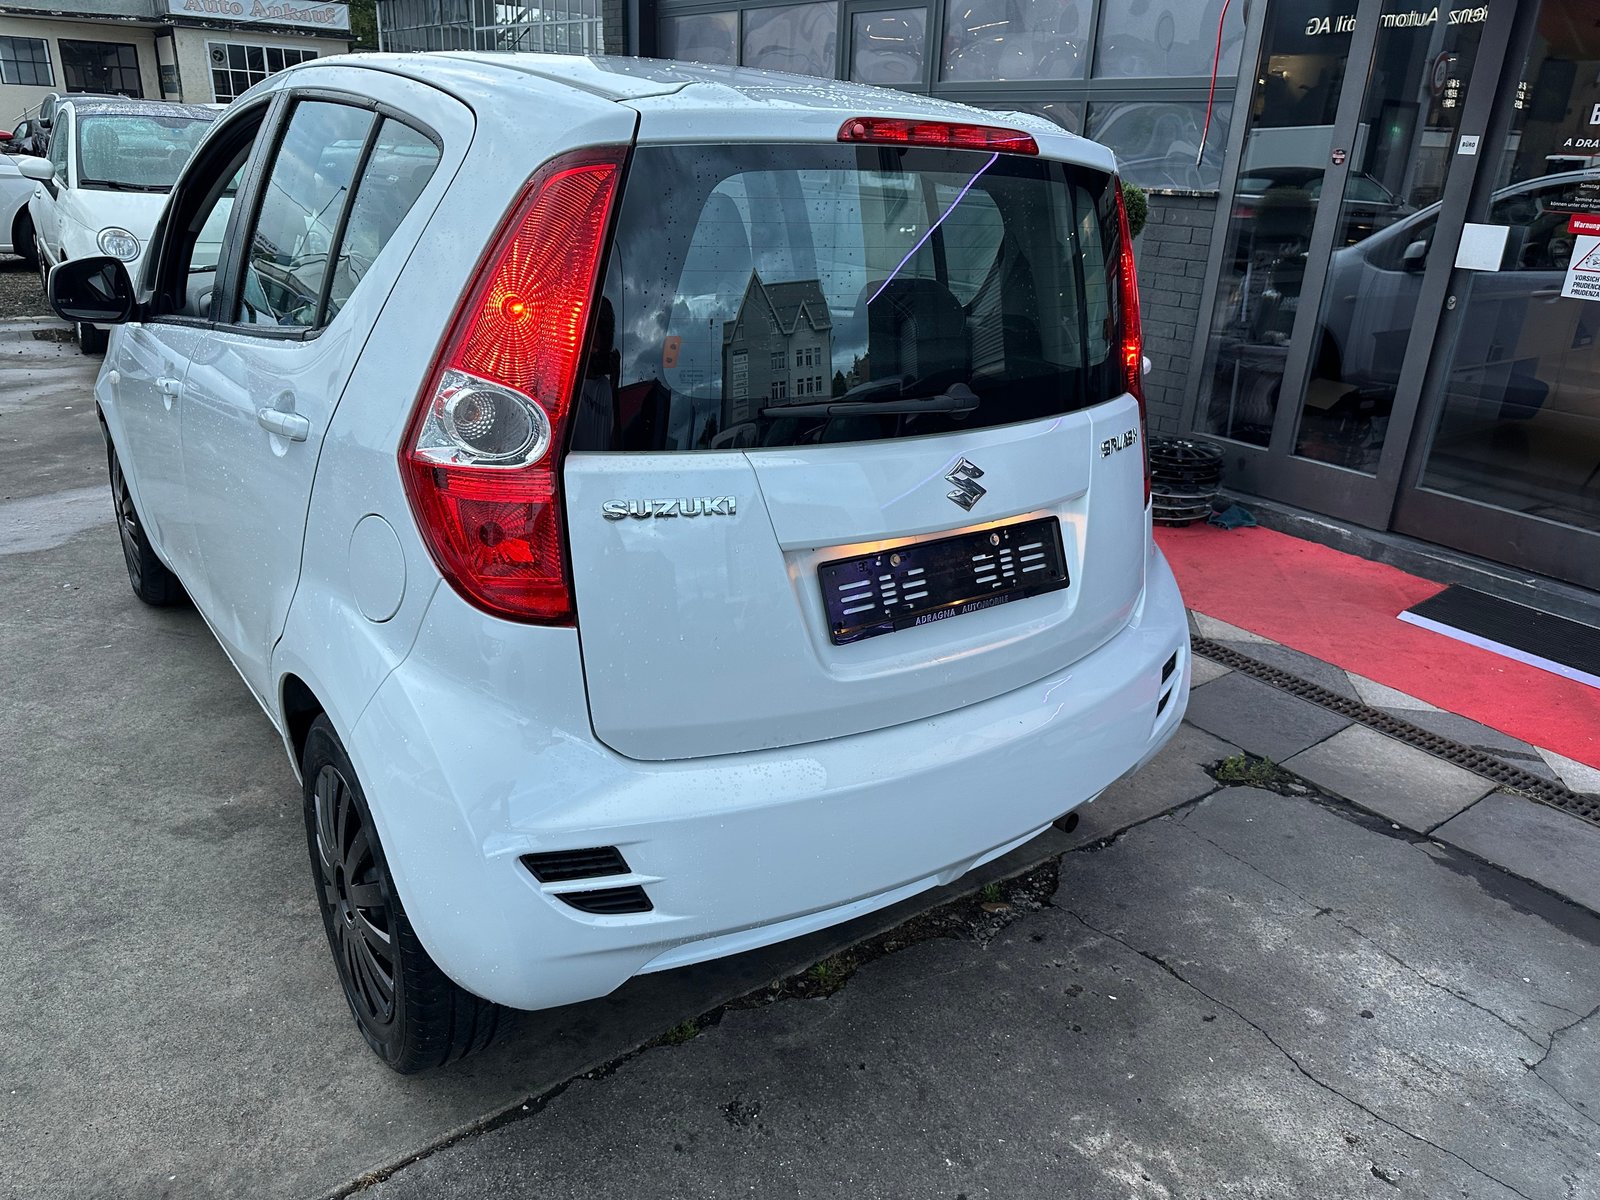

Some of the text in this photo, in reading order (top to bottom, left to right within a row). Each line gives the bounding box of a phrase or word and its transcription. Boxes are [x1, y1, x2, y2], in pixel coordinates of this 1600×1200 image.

[184, 0, 336, 25] Auto Ankauf
[1575, 138, 1600, 149] DRA
[1575, 274, 1600, 283] VORSICH
[602, 495, 737, 521] SUZUKI
[915, 594, 1009, 626] ADRAGNA AUTOMOBILE
